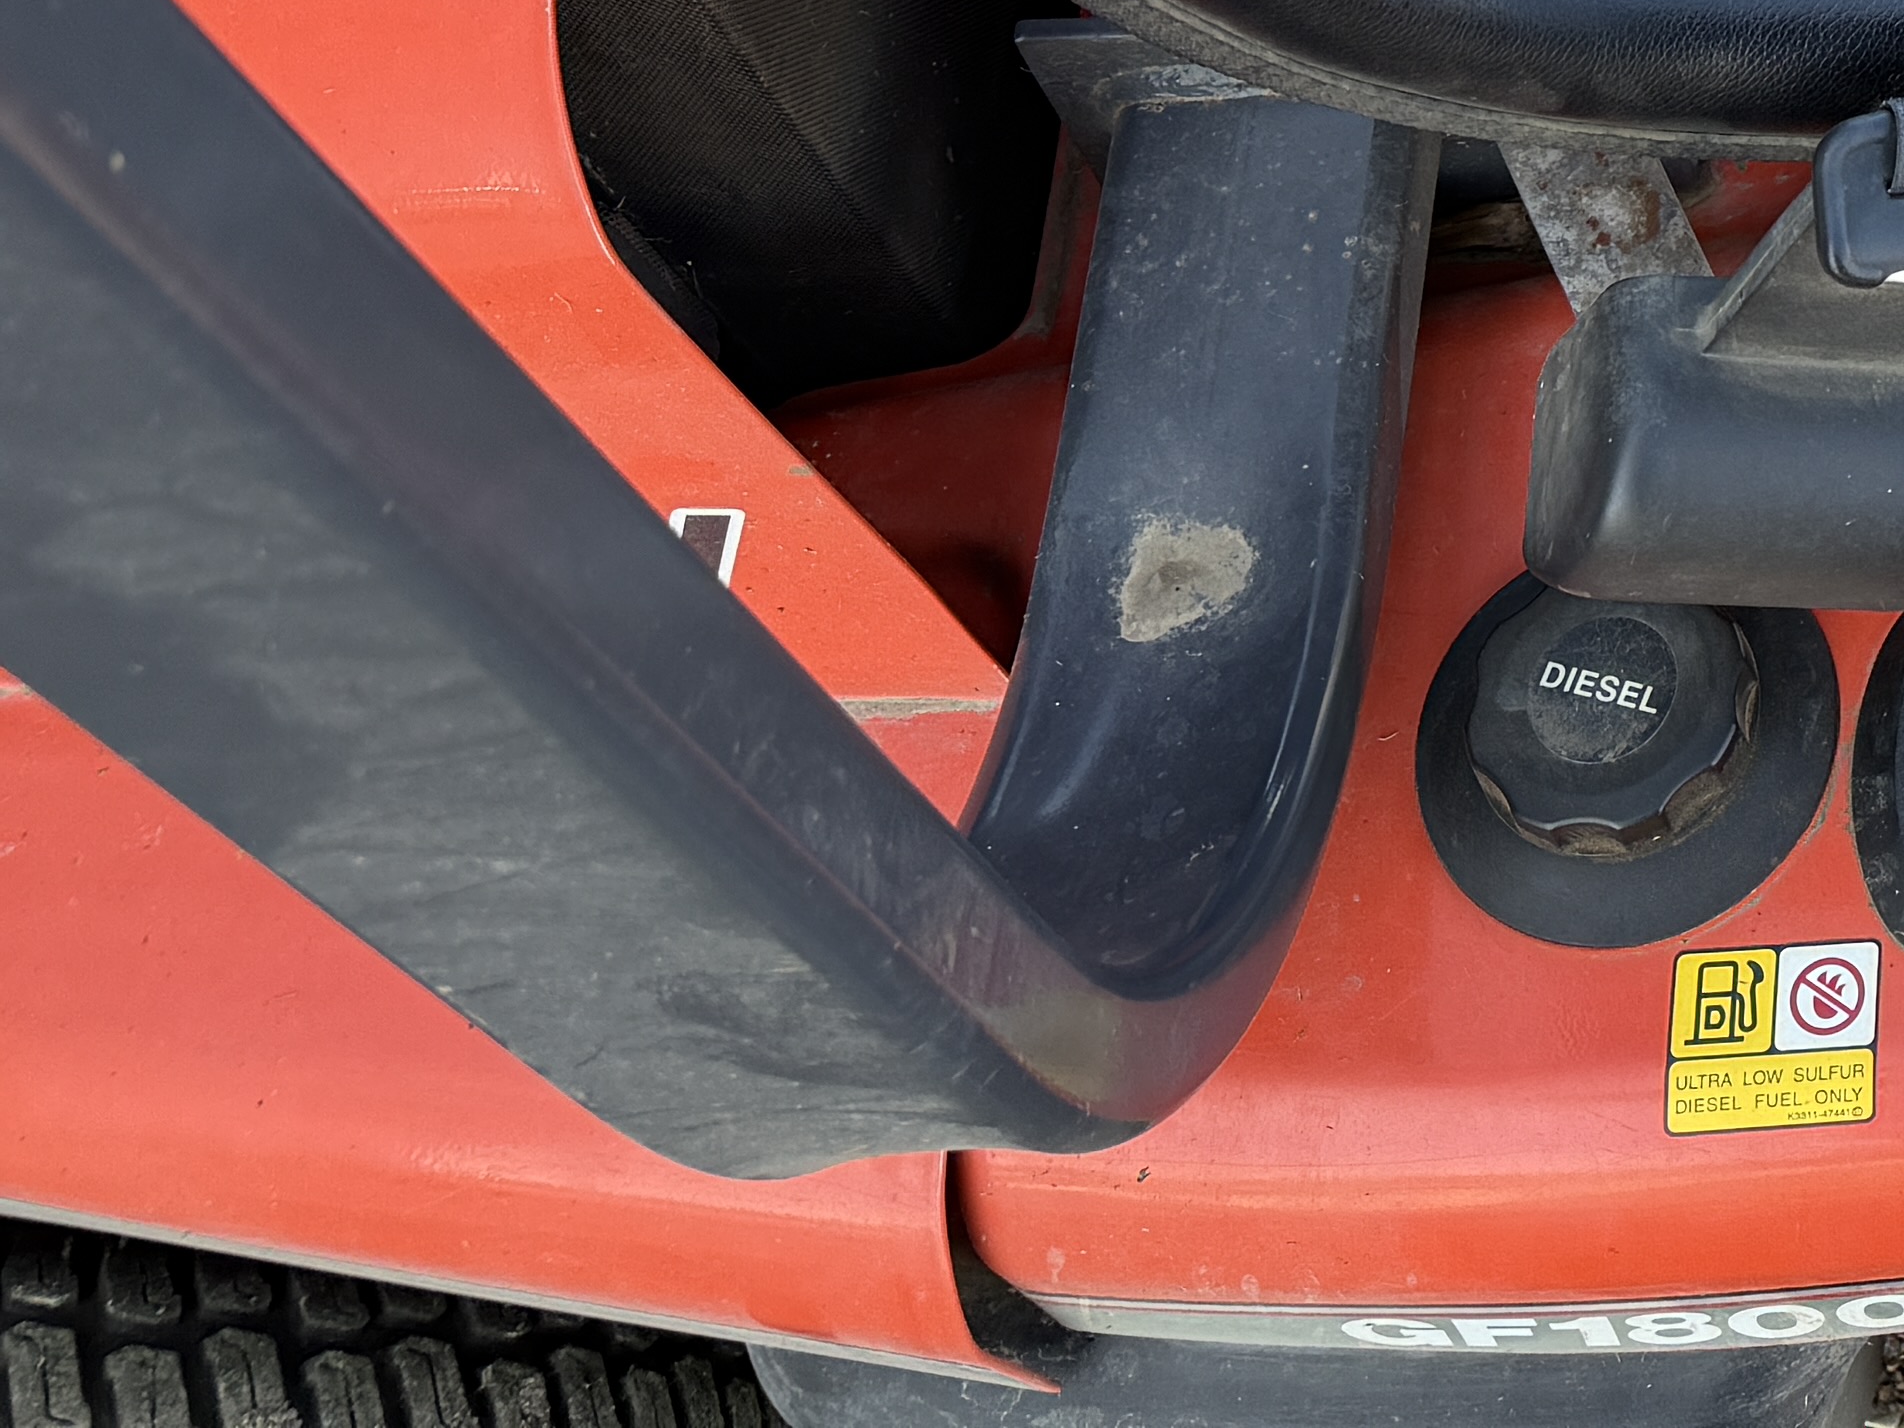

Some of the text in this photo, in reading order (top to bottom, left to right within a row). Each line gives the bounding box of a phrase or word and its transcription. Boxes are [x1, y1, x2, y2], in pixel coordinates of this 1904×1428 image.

[1539, 661, 1656, 713] DIESEL
[1675, 1063, 1864, 1091] ULTRA LOW SULFUR
[1675, 1086, 1863, 1115] DIESEL FUEL ONLY
